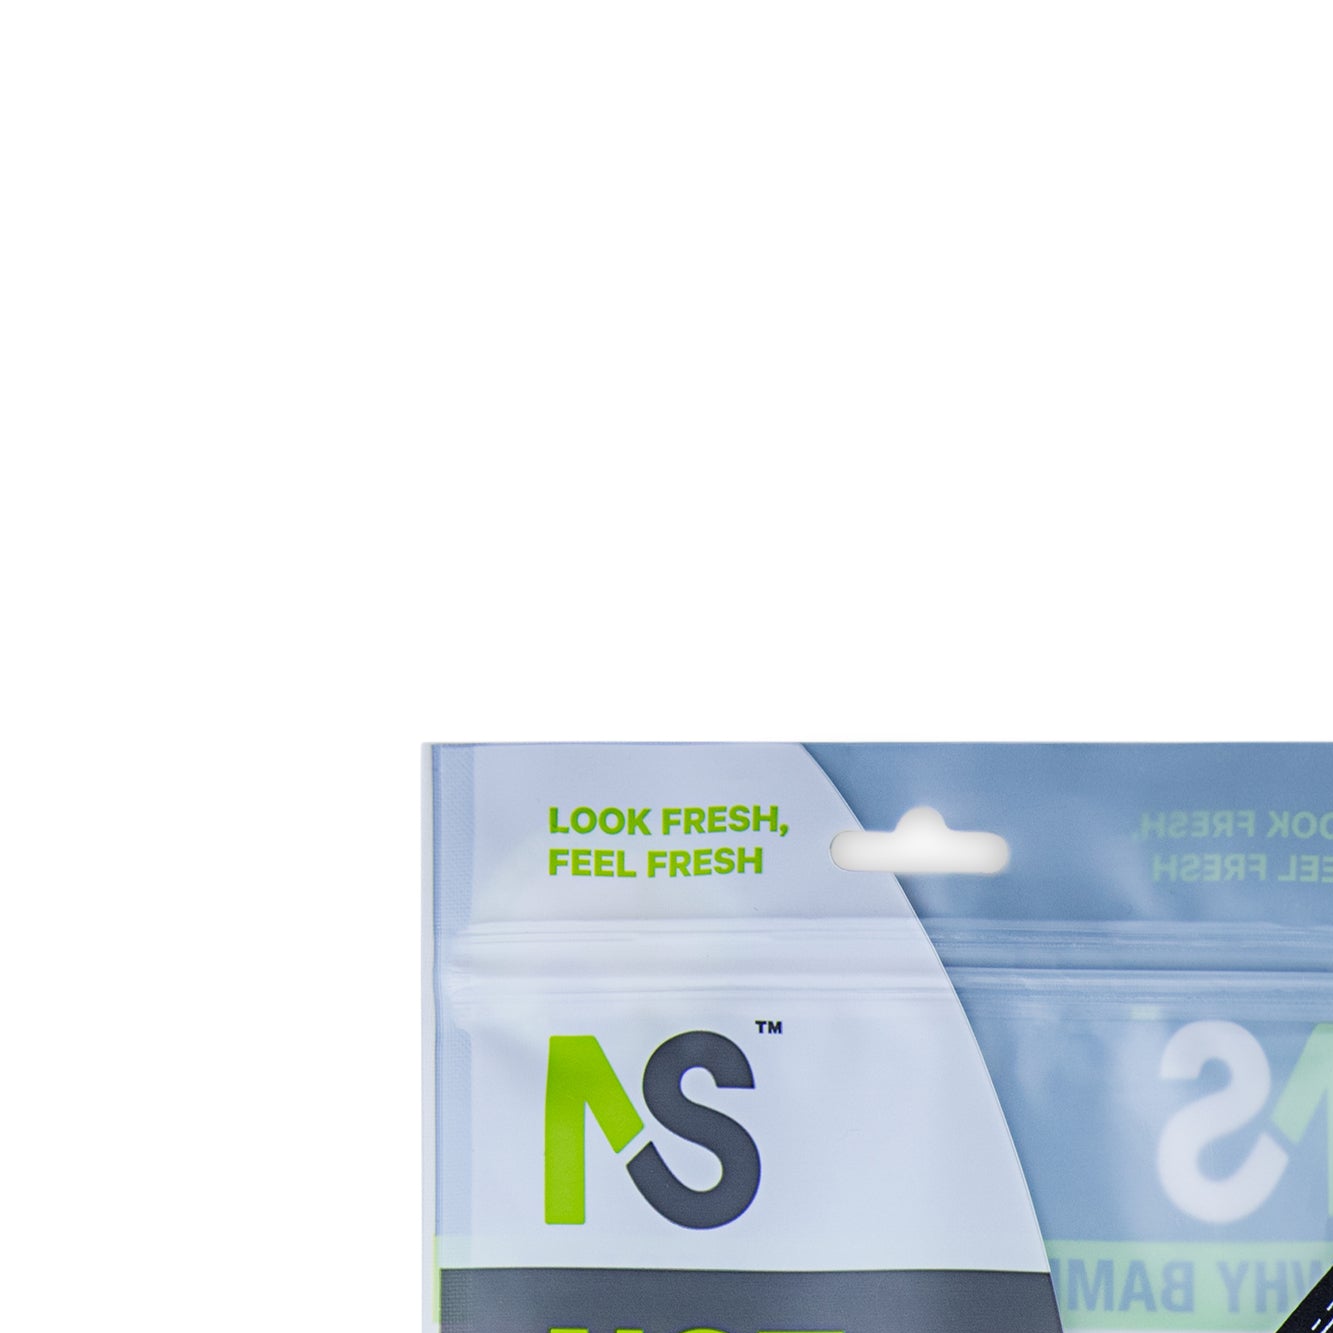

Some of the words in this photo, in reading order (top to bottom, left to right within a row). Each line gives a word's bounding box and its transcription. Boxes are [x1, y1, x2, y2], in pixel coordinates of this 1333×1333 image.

[549, 806, 652, 837] LOOK
[662, 804, 790, 838] FRESH,
[547, 848, 637, 878] FEEL
[647, 847, 764, 878] FRESH
